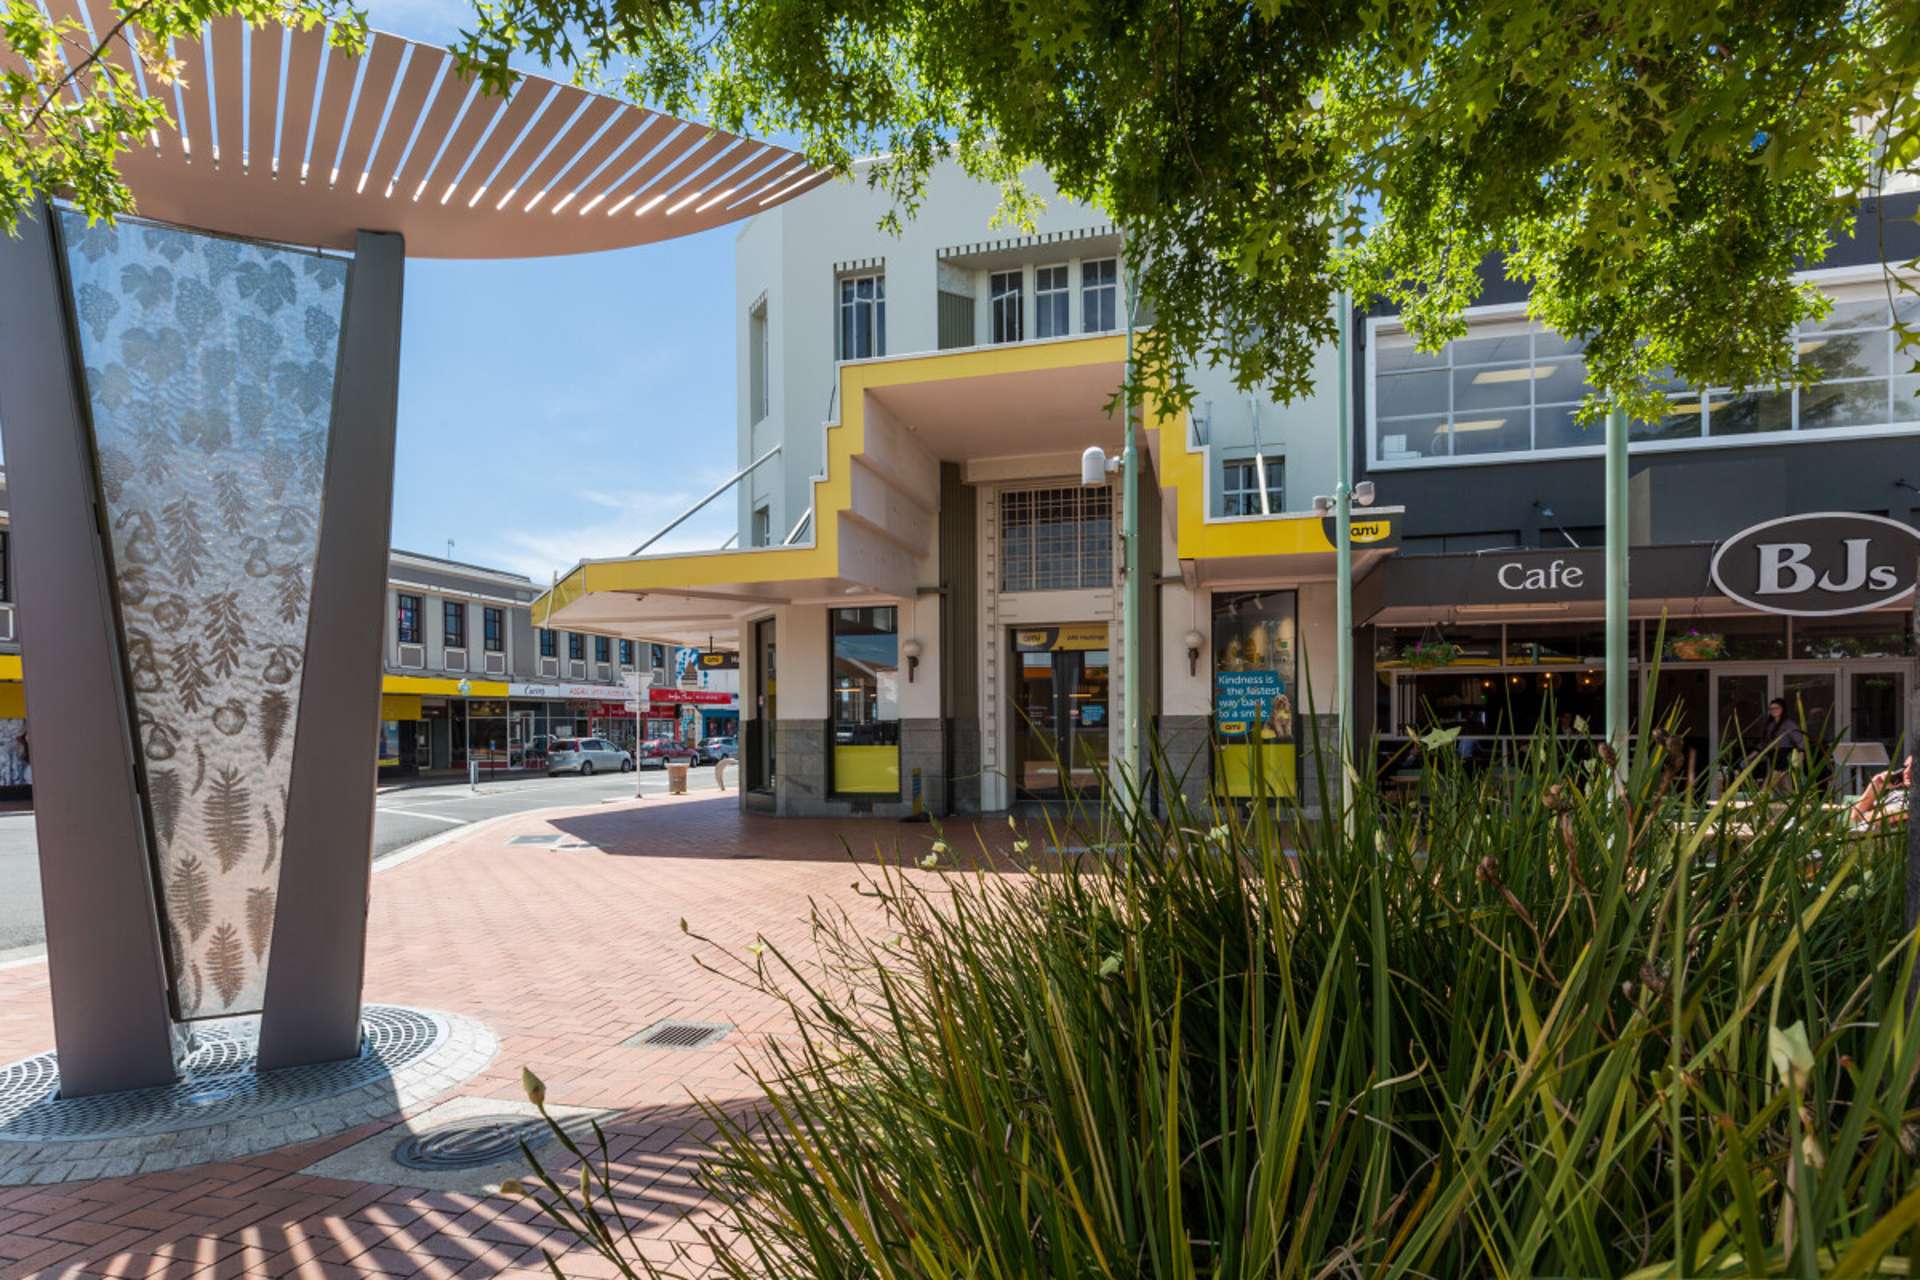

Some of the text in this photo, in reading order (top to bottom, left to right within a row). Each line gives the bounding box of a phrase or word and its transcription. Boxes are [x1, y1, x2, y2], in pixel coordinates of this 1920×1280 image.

[1351, 523, 1379, 537] ami
[1756, 538, 1898, 594] BJs
[1497, 560, 1584, 591] Cafe
[1218, 675, 1274, 684] Kindness is
[1227, 686, 1280, 696] the fastest
[1218, 700, 1238, 708] way
[1218, 710, 1230, 718] to
[1240, 710, 1270, 718] sme.
